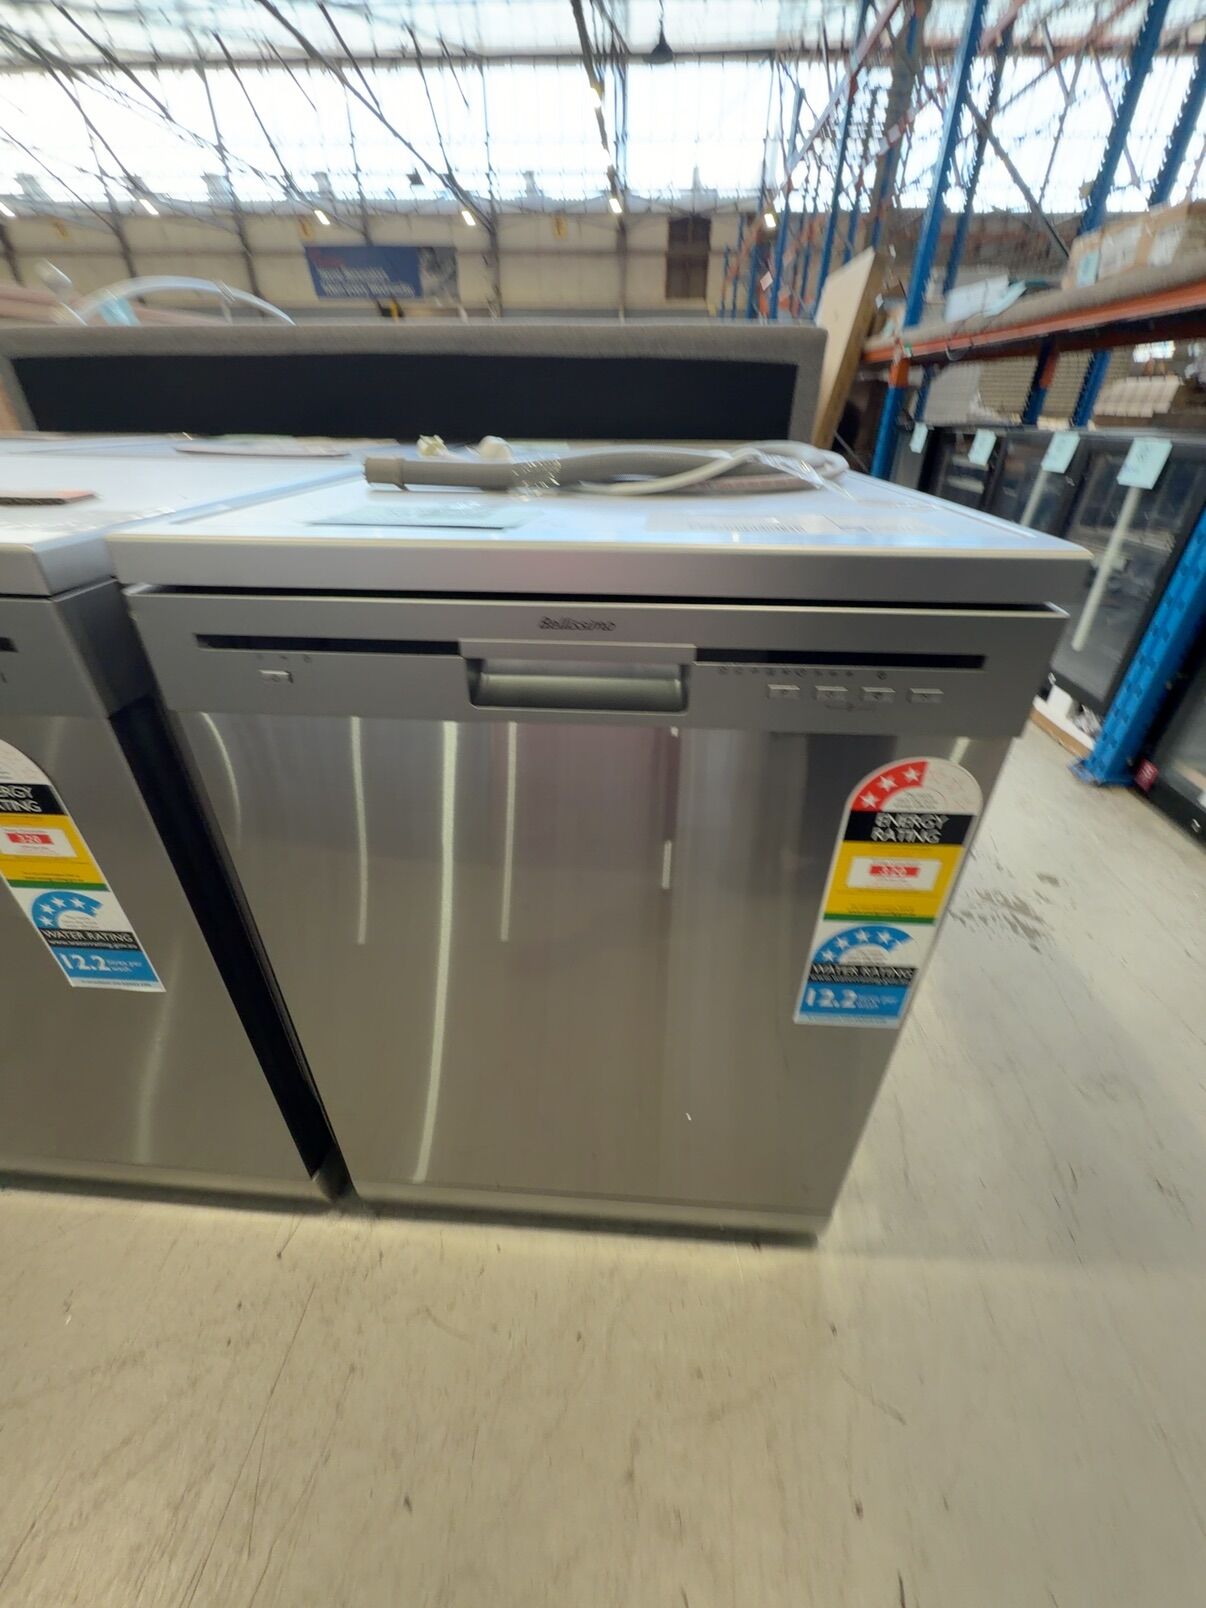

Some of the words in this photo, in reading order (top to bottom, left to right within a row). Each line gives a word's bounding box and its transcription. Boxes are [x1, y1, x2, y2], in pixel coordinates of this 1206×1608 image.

[538, 615, 617, 632] Bellissimo
[874, 812, 950, 830] ENERGY
[870, 827, 942, 844] RATING
[41, 929, 86, 941] WATER
[86, 932, 133, 943] RATING
[58, 952, 111, 972] 12.2
[804, 987, 858, 1009] 12.2
